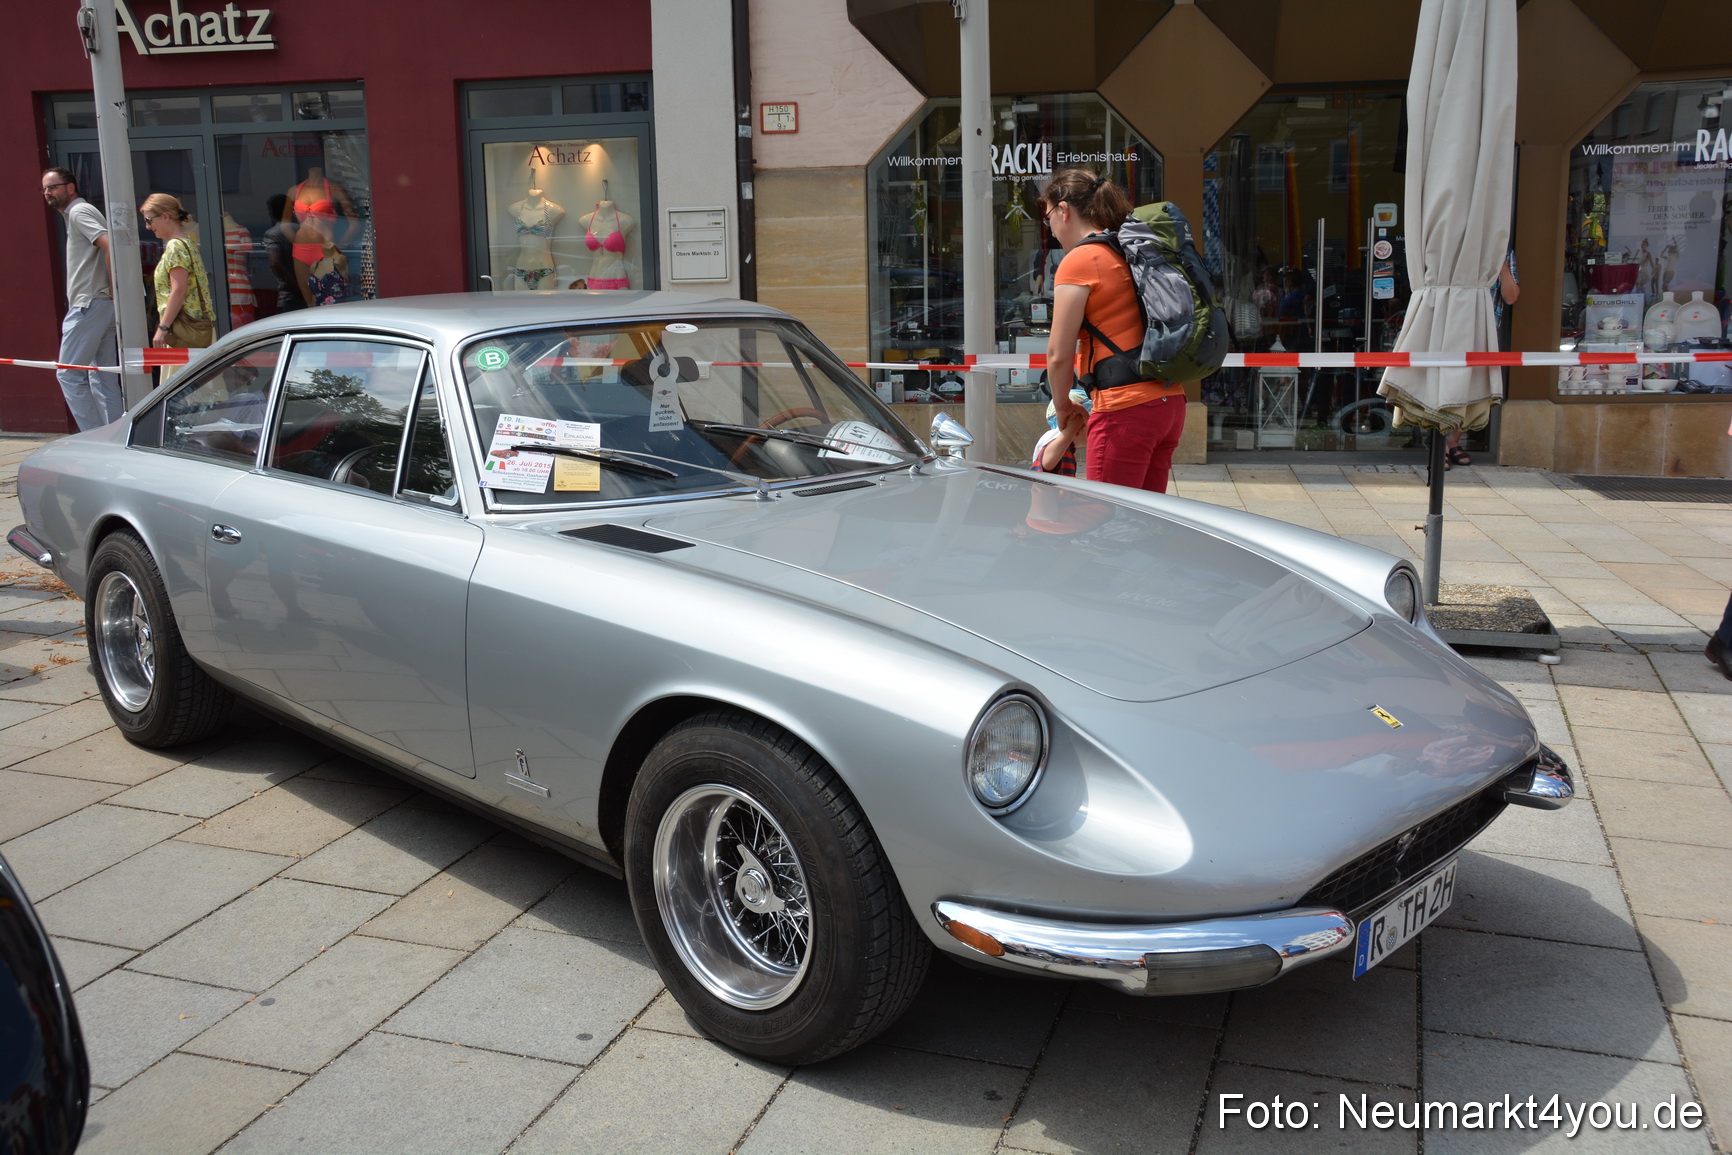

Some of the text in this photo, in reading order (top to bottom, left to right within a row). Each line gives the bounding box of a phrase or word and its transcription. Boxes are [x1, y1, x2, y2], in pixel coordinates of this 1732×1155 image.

[1582, 141, 1690, 155] Willkommen im
[528, 145, 592, 166] Achatz
[887, 150, 1141, 167] Willkommen Erlebnishaus.
[991, 143, 1052, 174] RACKL
[1008, 175, 1020, 183] Tag
[1648, 205, 1675, 213] FEIERN
[1671, 212, 1707, 220] SOMMER.
[484, 352, 501, 365] B
[1370, 864, 1456, 962] R TH 2H
[1358, 954, 1365, 967] D
